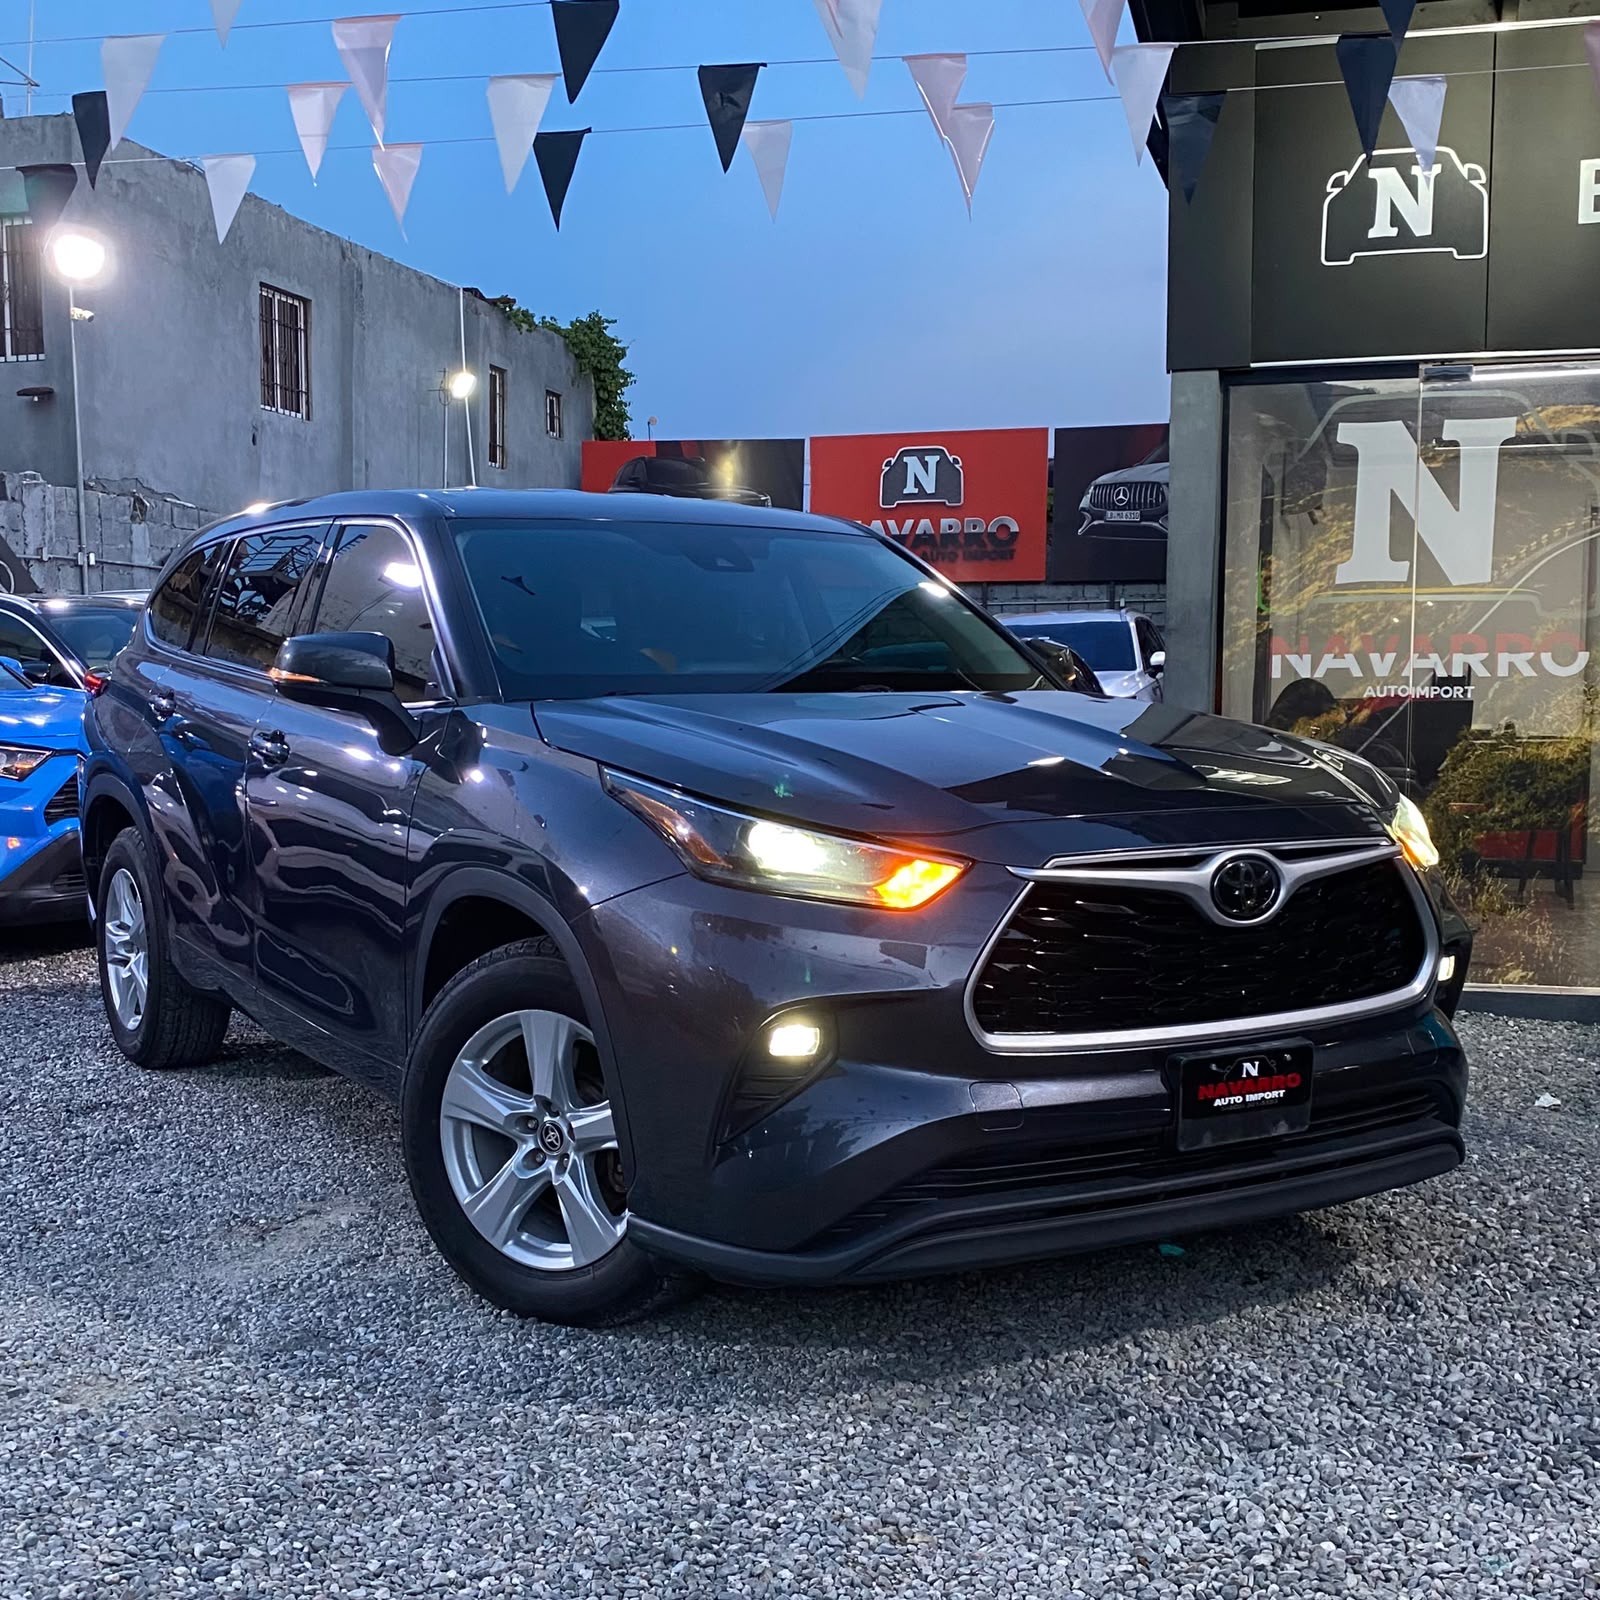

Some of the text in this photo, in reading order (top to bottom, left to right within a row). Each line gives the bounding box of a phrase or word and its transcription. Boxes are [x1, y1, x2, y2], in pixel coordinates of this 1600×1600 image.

[1367, 164, 1441, 240] N
[903, 455, 940, 495] N
[1335, 416, 1518, 586] N
[919, 548, 1016, 563] AUTO IMPORT
[1270, 632, 1590, 679] NAVARRO
[1241, 1061, 1259, 1078] N
[1198, 1073, 1301, 1100] NAVARRO
[1213, 1096, 1243, 1107] AUTO
[1245, 1089, 1286, 1103] IMPORT
